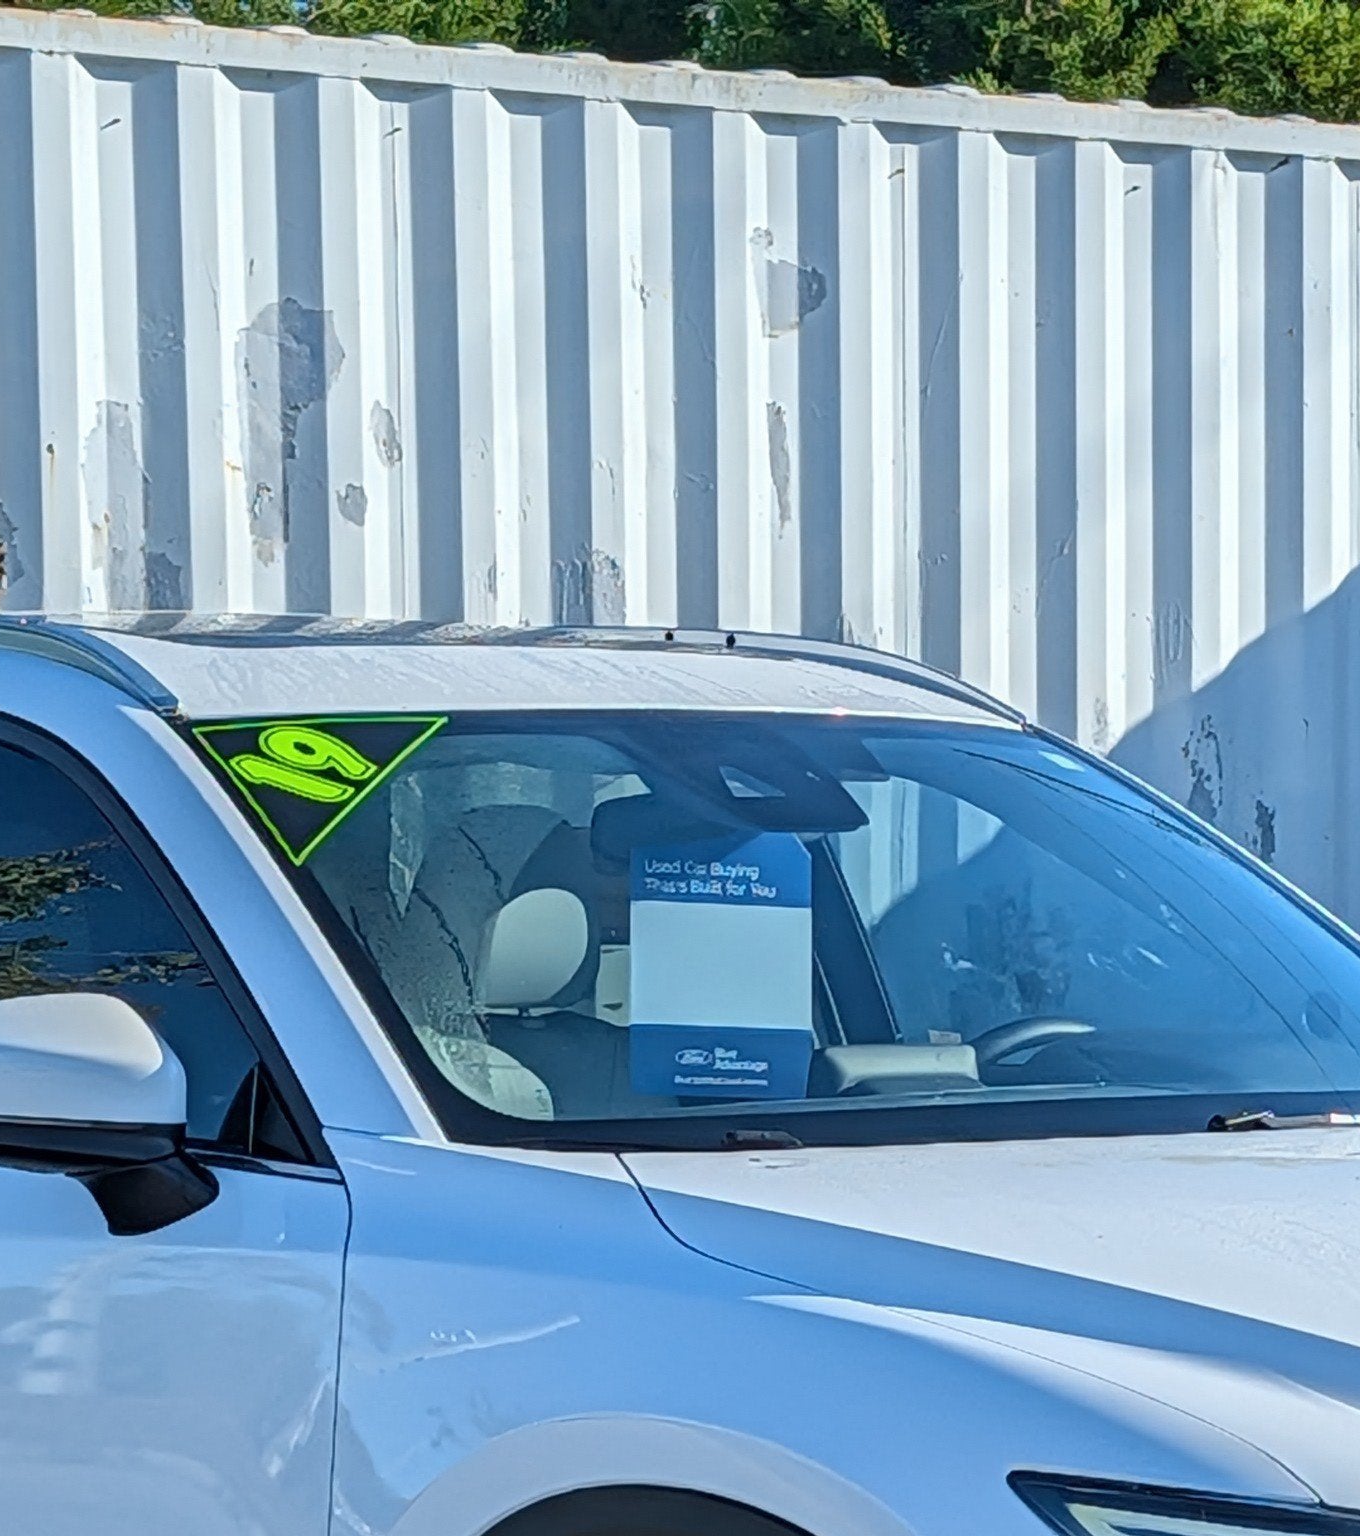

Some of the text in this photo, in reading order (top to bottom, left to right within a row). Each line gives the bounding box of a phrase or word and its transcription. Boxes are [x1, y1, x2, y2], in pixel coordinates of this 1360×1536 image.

[229, 726, 378, 802] 19
[644, 860, 759, 881] Used Car Buying
[725, 880, 747, 896] for
[750, 882, 776, 898] You
